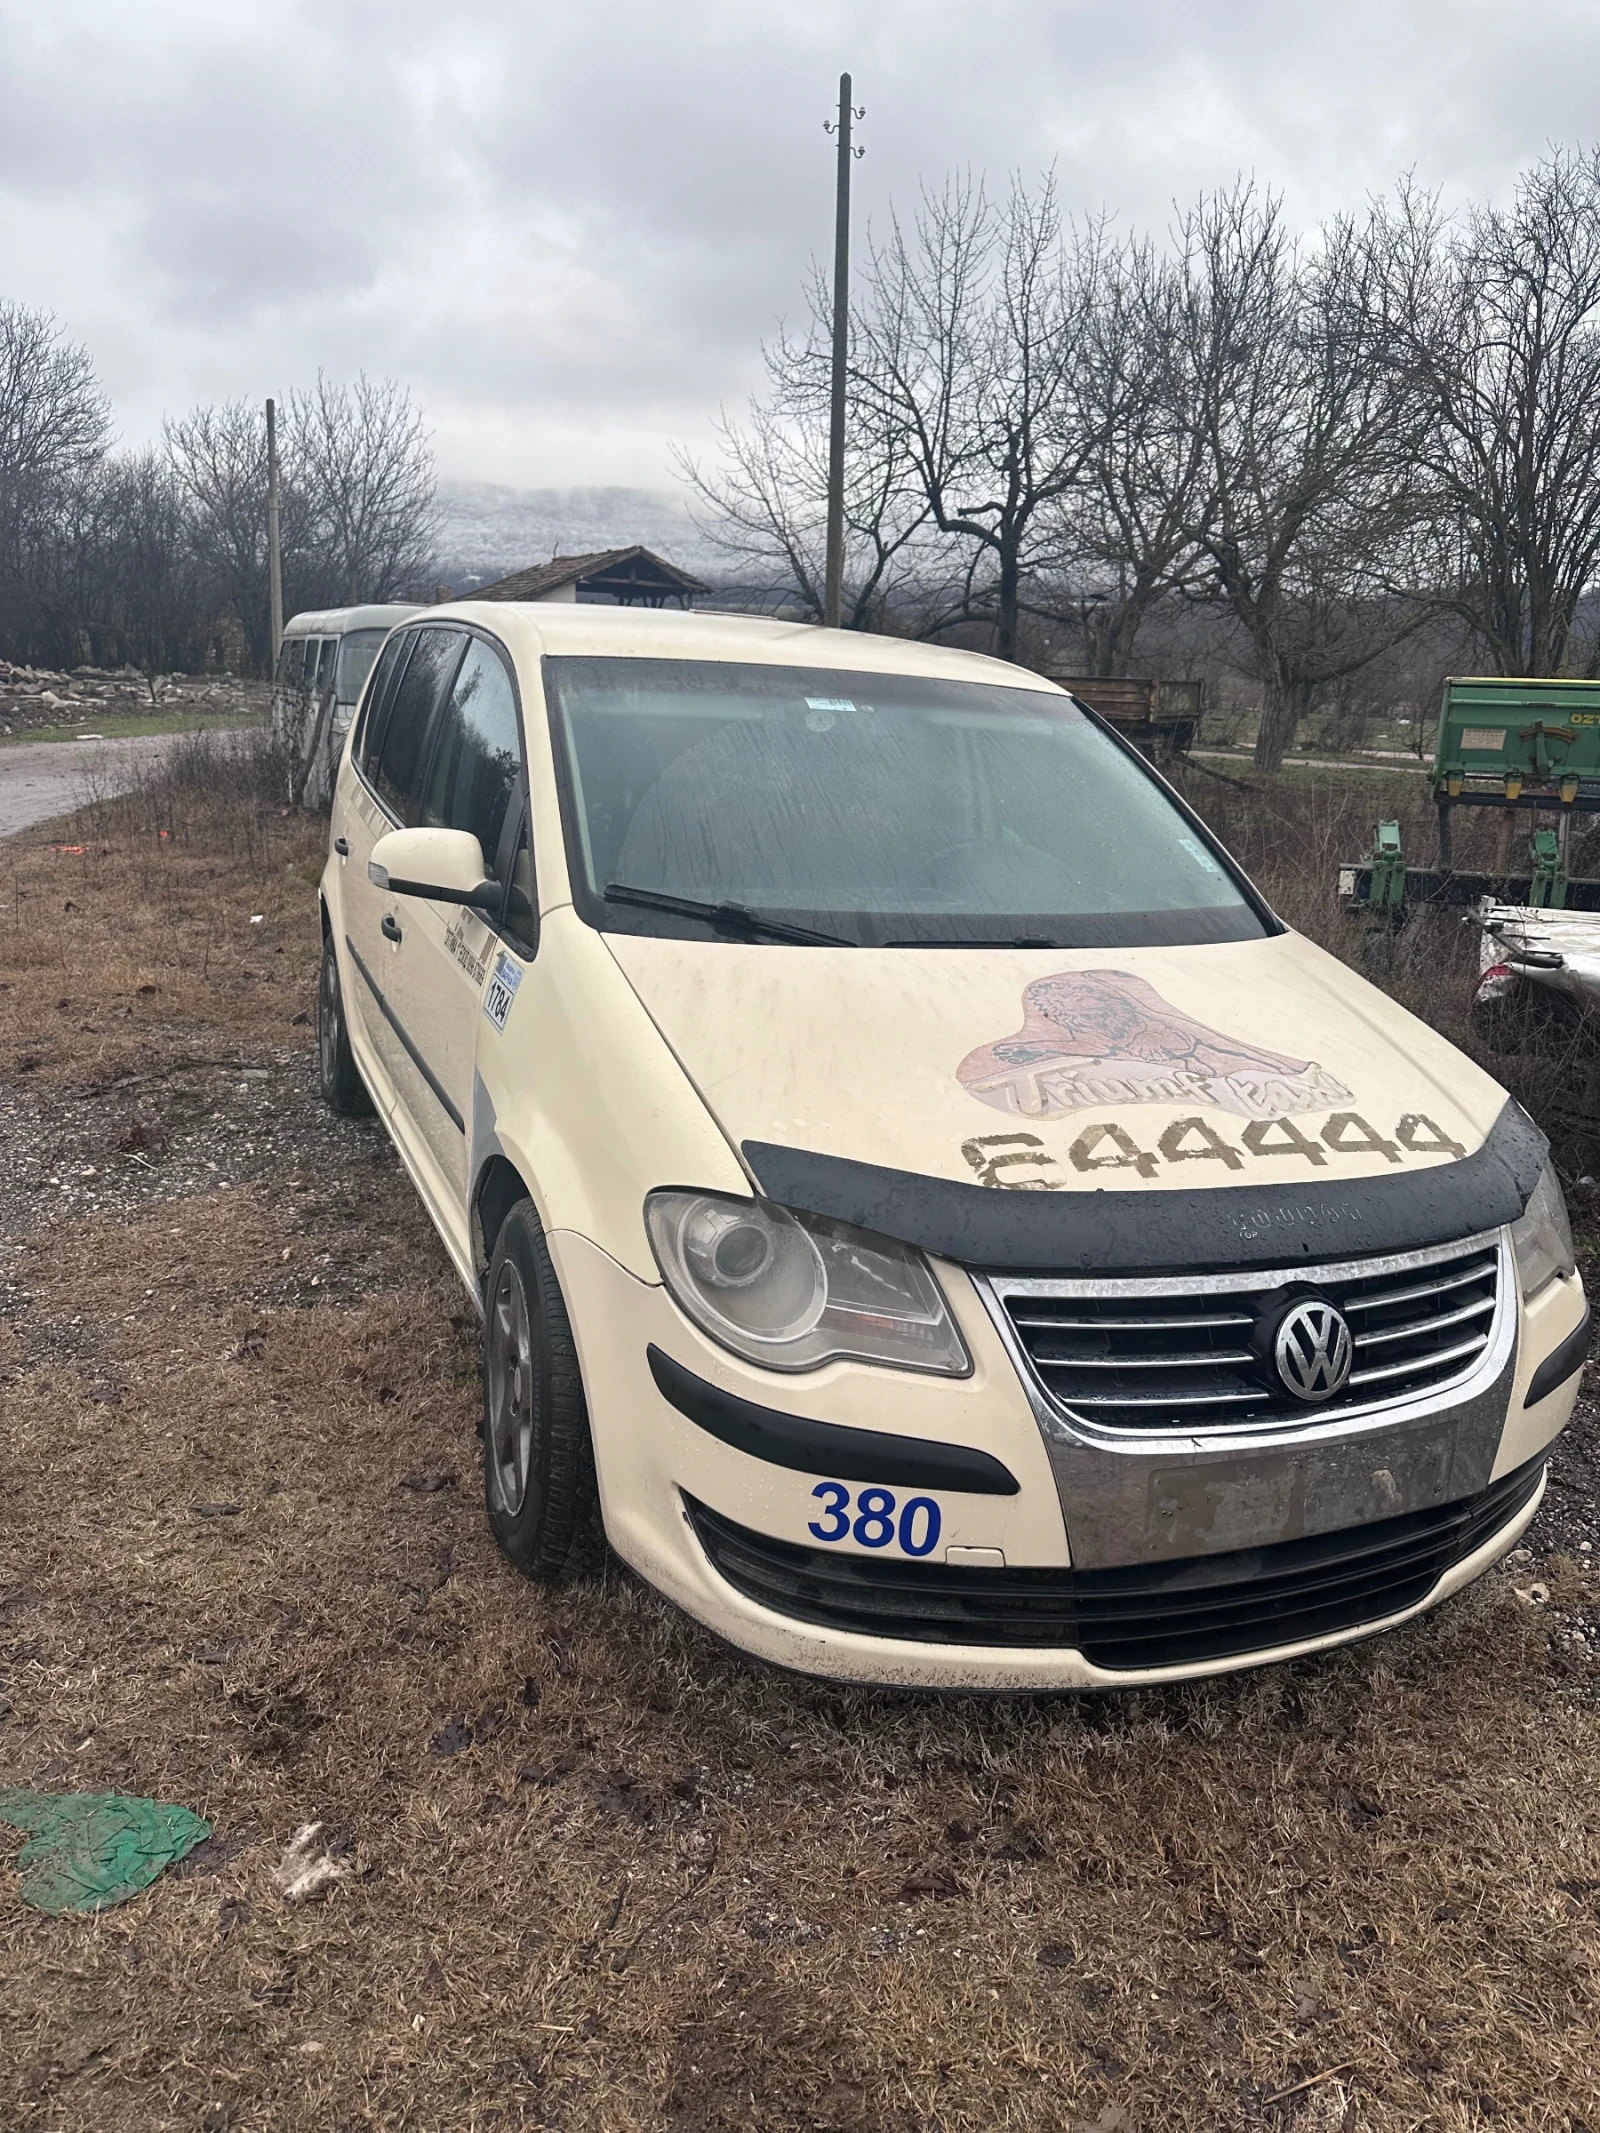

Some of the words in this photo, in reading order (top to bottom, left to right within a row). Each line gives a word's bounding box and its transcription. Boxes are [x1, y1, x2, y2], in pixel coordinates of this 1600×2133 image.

[487, 981, 511, 1023] 1784
[963, 1056, 1219, 1116] Triumf
[960, 1112, 1467, 1191] 644444
[1280, 1303, 1348, 1397] VW
[808, 1482, 941, 1556] 380
